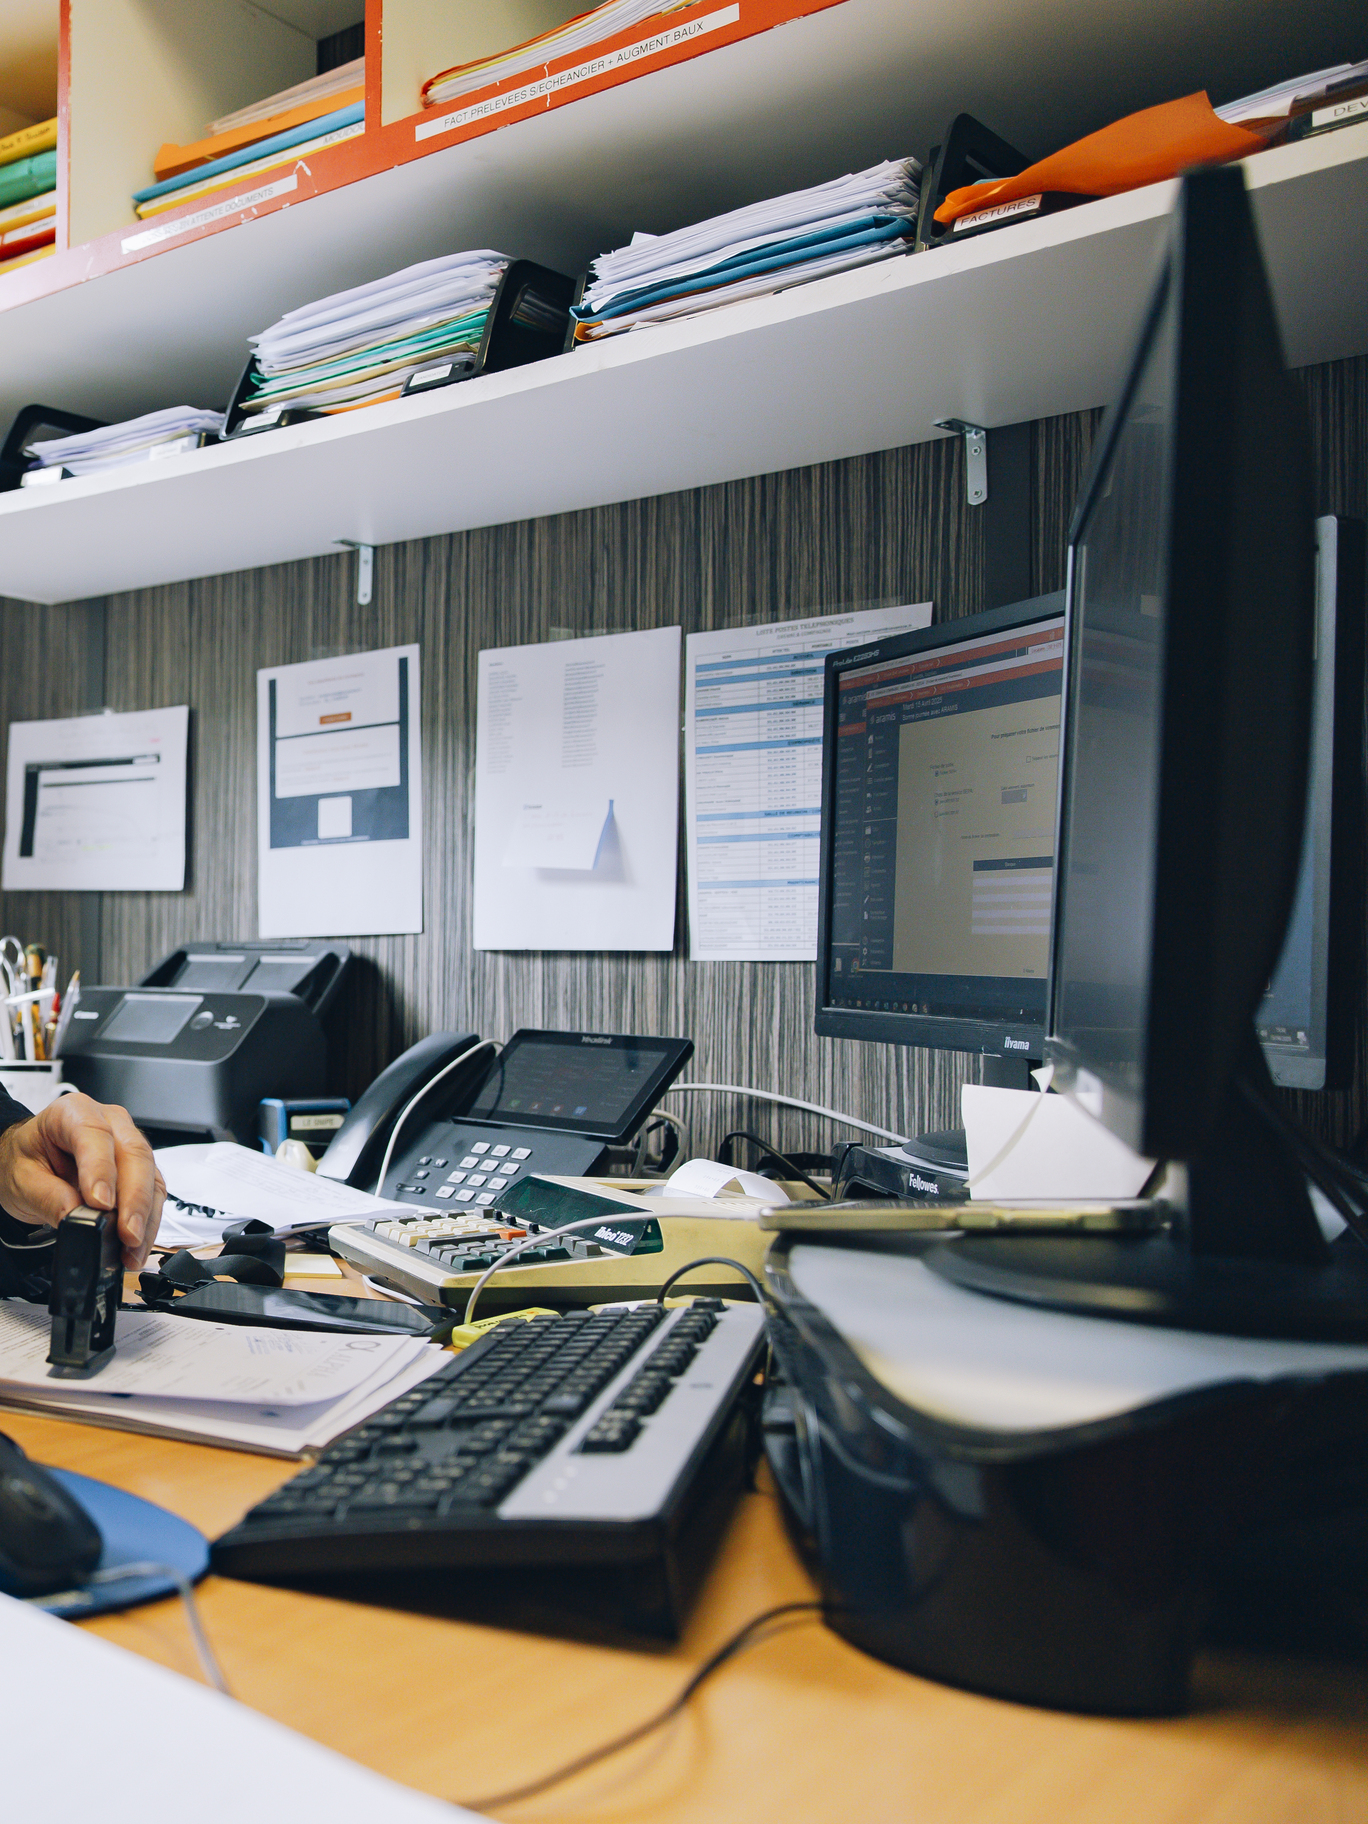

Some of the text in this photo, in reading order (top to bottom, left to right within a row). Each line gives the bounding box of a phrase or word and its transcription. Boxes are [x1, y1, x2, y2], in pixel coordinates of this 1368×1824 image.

[444, 21, 704, 128] FACT.PRELEVEES S/ECHEANCIER + AUGMENT.BAUX
[1334, 101, 1368, 117] DEV
[190, 205, 225, 227] ATTENTE
[224, 187, 274, 214] DOCUMENTS
[960, 198, 1036, 226] FACTURES
[1004, 1036, 1030, 1050] iiyama
[909, 1173, 939, 1194] Fellowes
[594, 1226, 617, 1241] ibico
